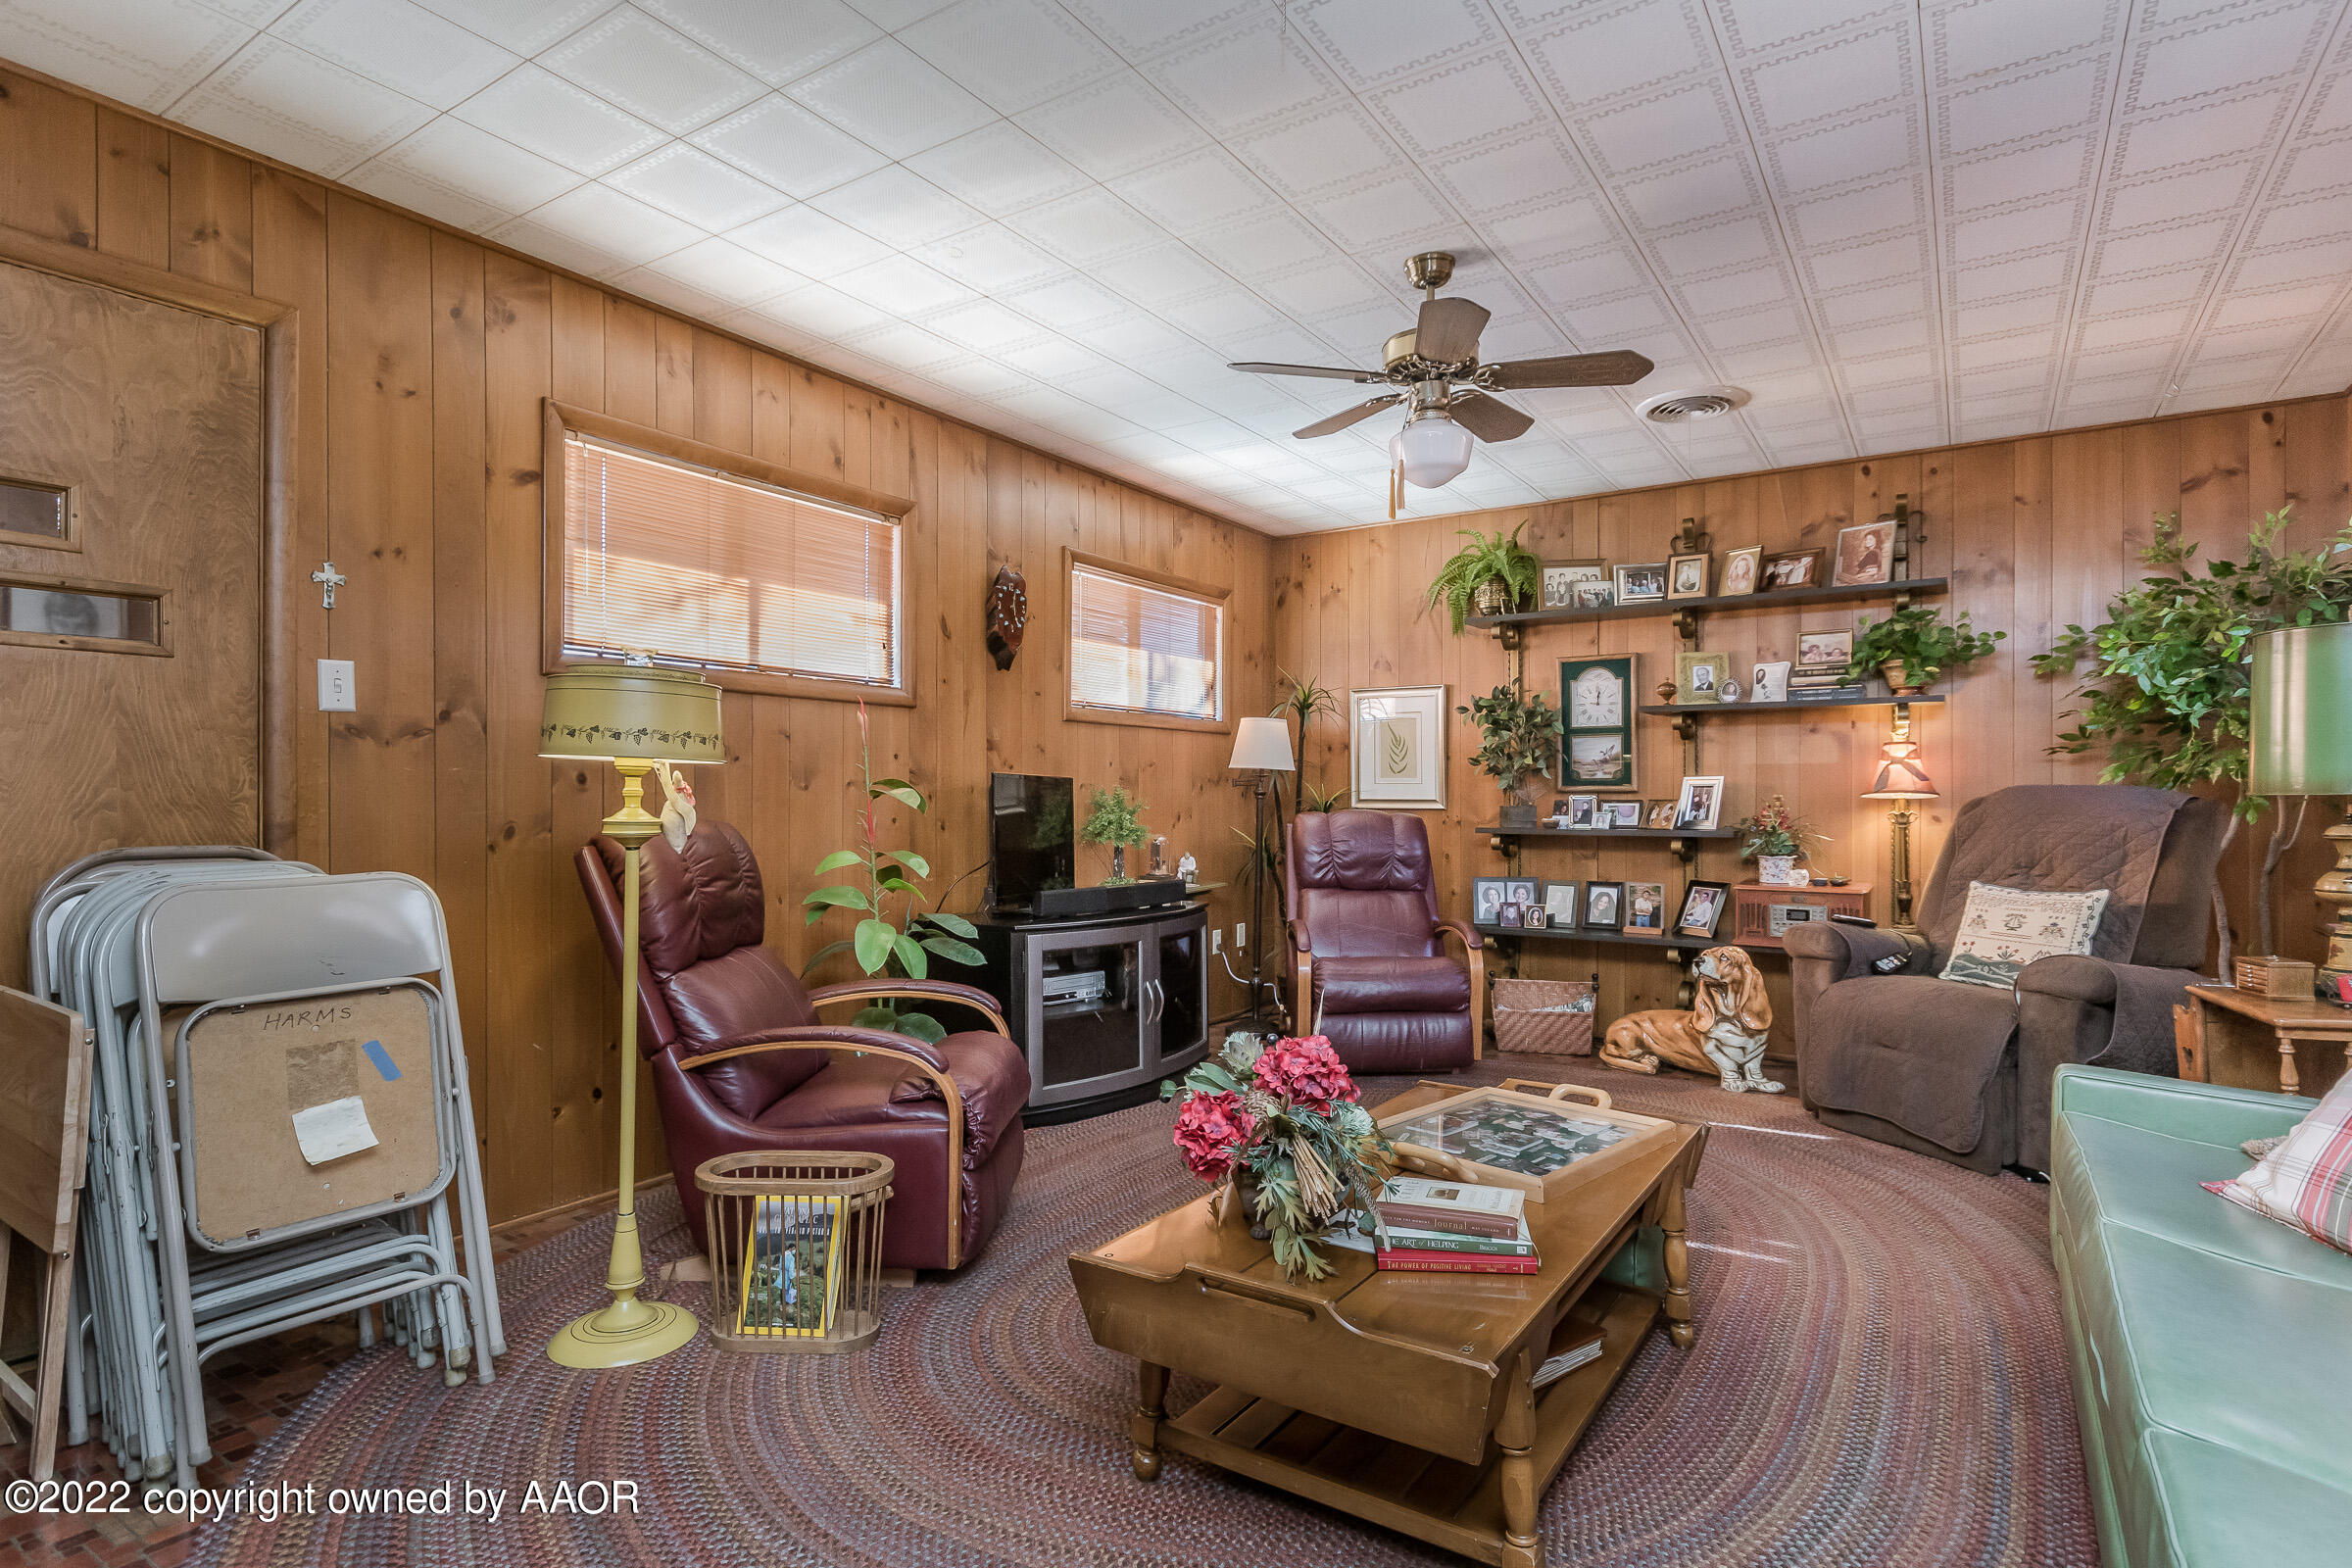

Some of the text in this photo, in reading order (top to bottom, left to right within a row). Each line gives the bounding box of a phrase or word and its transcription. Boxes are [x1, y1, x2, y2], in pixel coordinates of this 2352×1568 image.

[263, 1007, 351, 1030] HARMS
[1434, 1218, 1467, 1230] Journal
[1401, 1238, 1418, 1249] ART
[1427, 1240, 1459, 1250] HELPING
